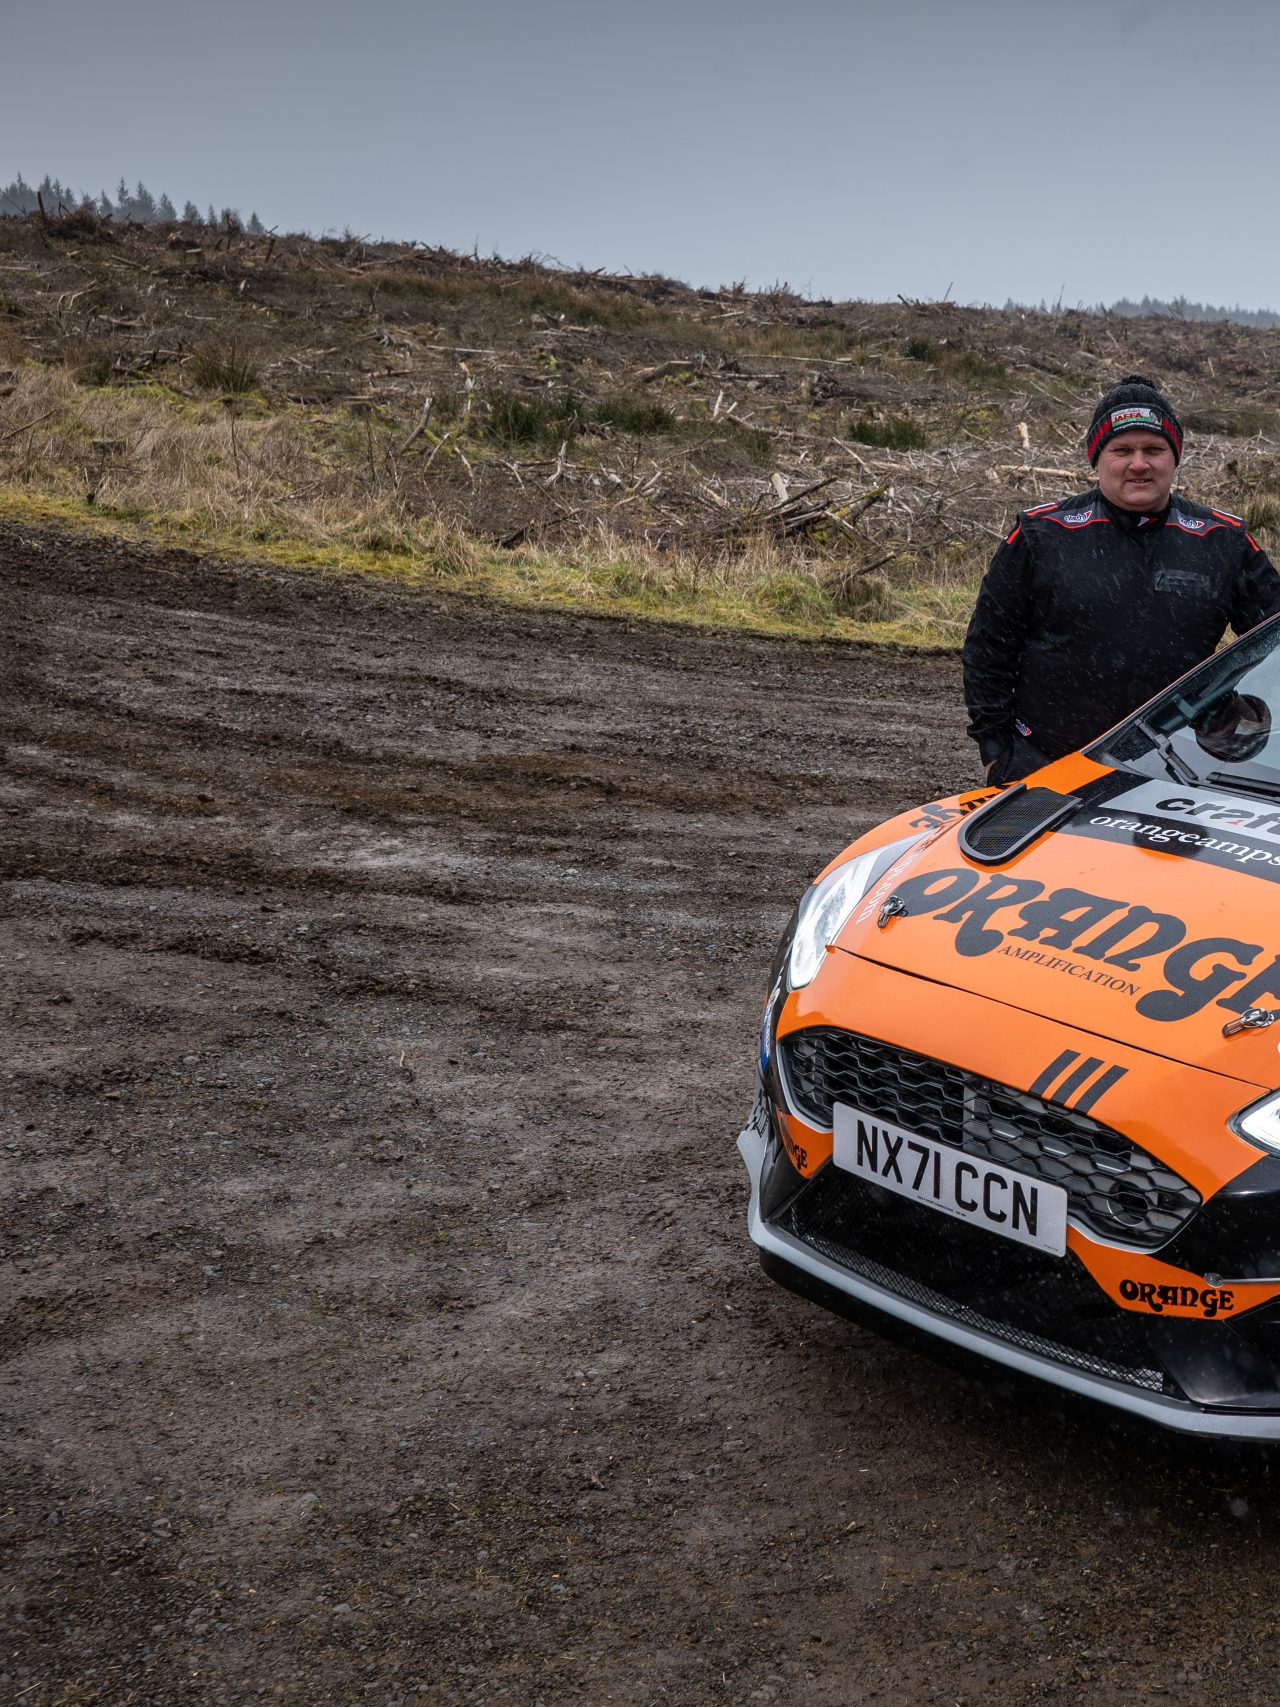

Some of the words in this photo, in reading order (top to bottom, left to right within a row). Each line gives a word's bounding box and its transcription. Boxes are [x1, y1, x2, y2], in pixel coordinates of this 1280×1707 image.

[997, 943, 1141, 995] AMPLIFICATION
[856, 1119, 941, 1200] NX71
[953, 1160, 1039, 1237] CCN
[1118, 1279, 1235, 1318] ORANGE
